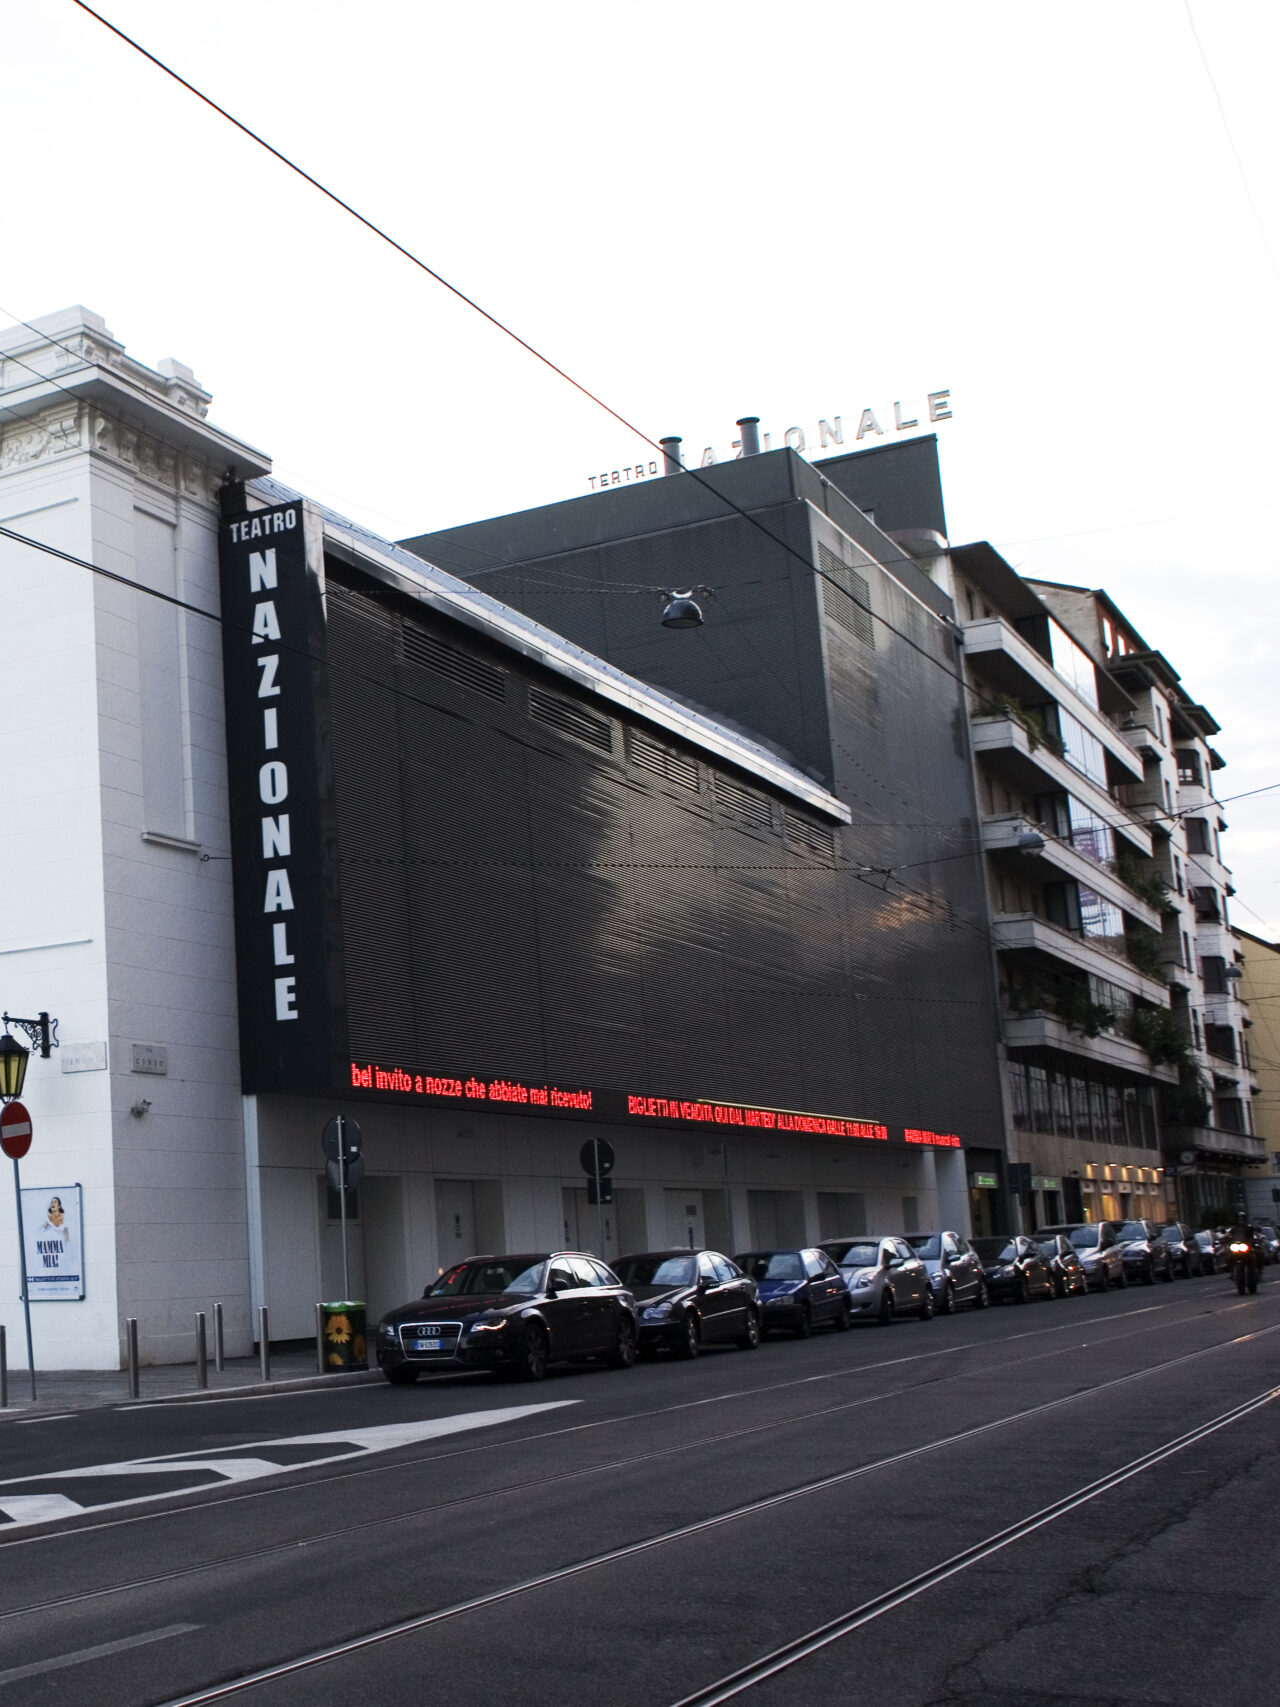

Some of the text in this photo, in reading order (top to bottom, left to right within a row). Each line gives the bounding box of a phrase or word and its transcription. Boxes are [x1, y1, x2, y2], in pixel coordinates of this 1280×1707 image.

[229, 508, 297, 543] TEATRO
[248, 547, 299, 1021] NAZIONALE
[350, 1063, 372, 1087] bel
[375, 1066, 412, 1091] invito
[414, 1076, 424, 1093] a
[426, 1077, 462, 1097] nozze
[465, 1077, 486, 1099] che
[36, 1240, 64, 1254] MAMMA
[42, 1254, 59, 1268] MIA!
